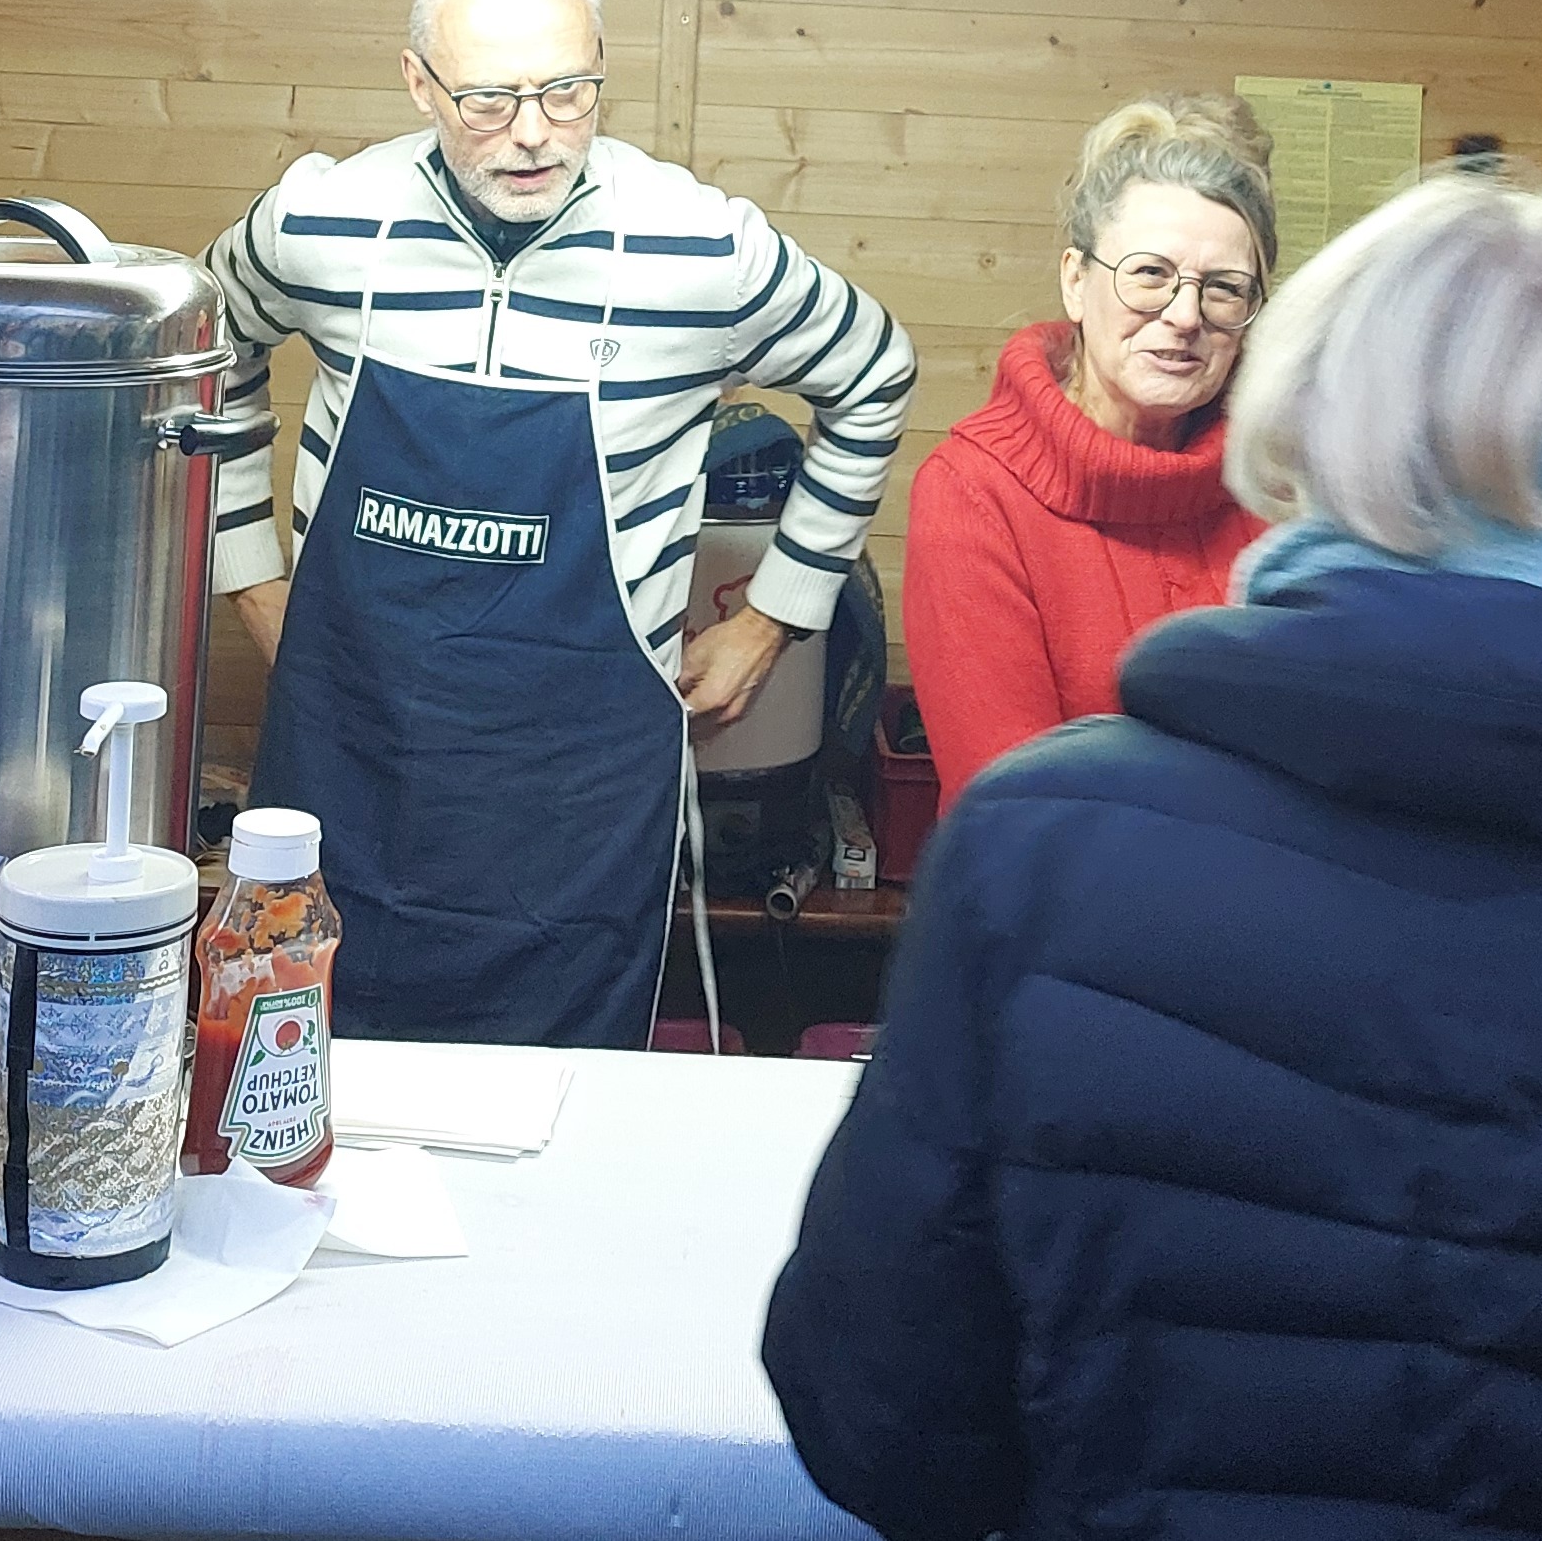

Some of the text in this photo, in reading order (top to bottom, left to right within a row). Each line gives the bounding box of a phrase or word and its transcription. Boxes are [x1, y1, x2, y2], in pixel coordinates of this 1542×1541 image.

[361, 497, 543, 556] RAMAZZOTTI
[247, 1062, 317, 1091] KETCHUP
[242, 1079, 319, 1115] TOMATO
[249, 1119, 310, 1151] HEINZ
